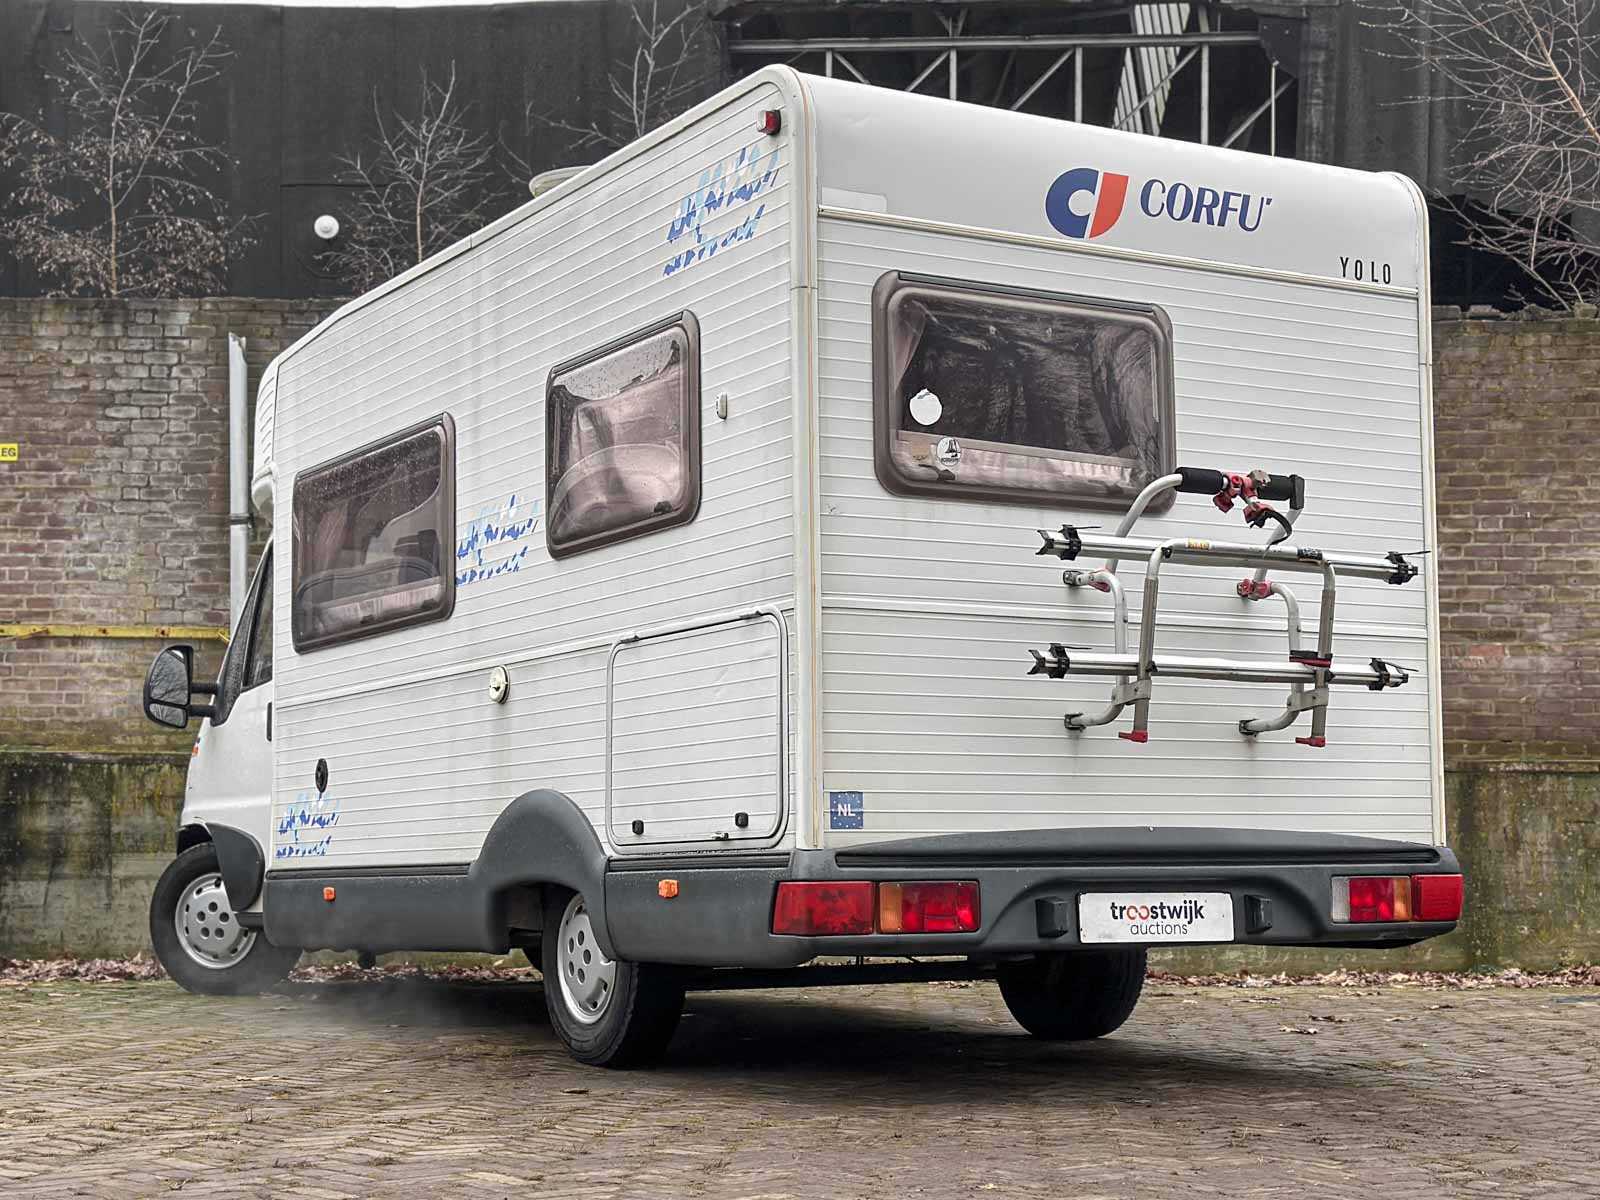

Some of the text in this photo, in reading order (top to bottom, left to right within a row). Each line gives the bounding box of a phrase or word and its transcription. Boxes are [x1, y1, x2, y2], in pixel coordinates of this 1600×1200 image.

[1339, 256, 1391, 285] YOLO
[837, 803, 856, 817] NL
[1110, 899, 1205, 925] troostwijk
[1130, 921, 1188, 936] auctions
